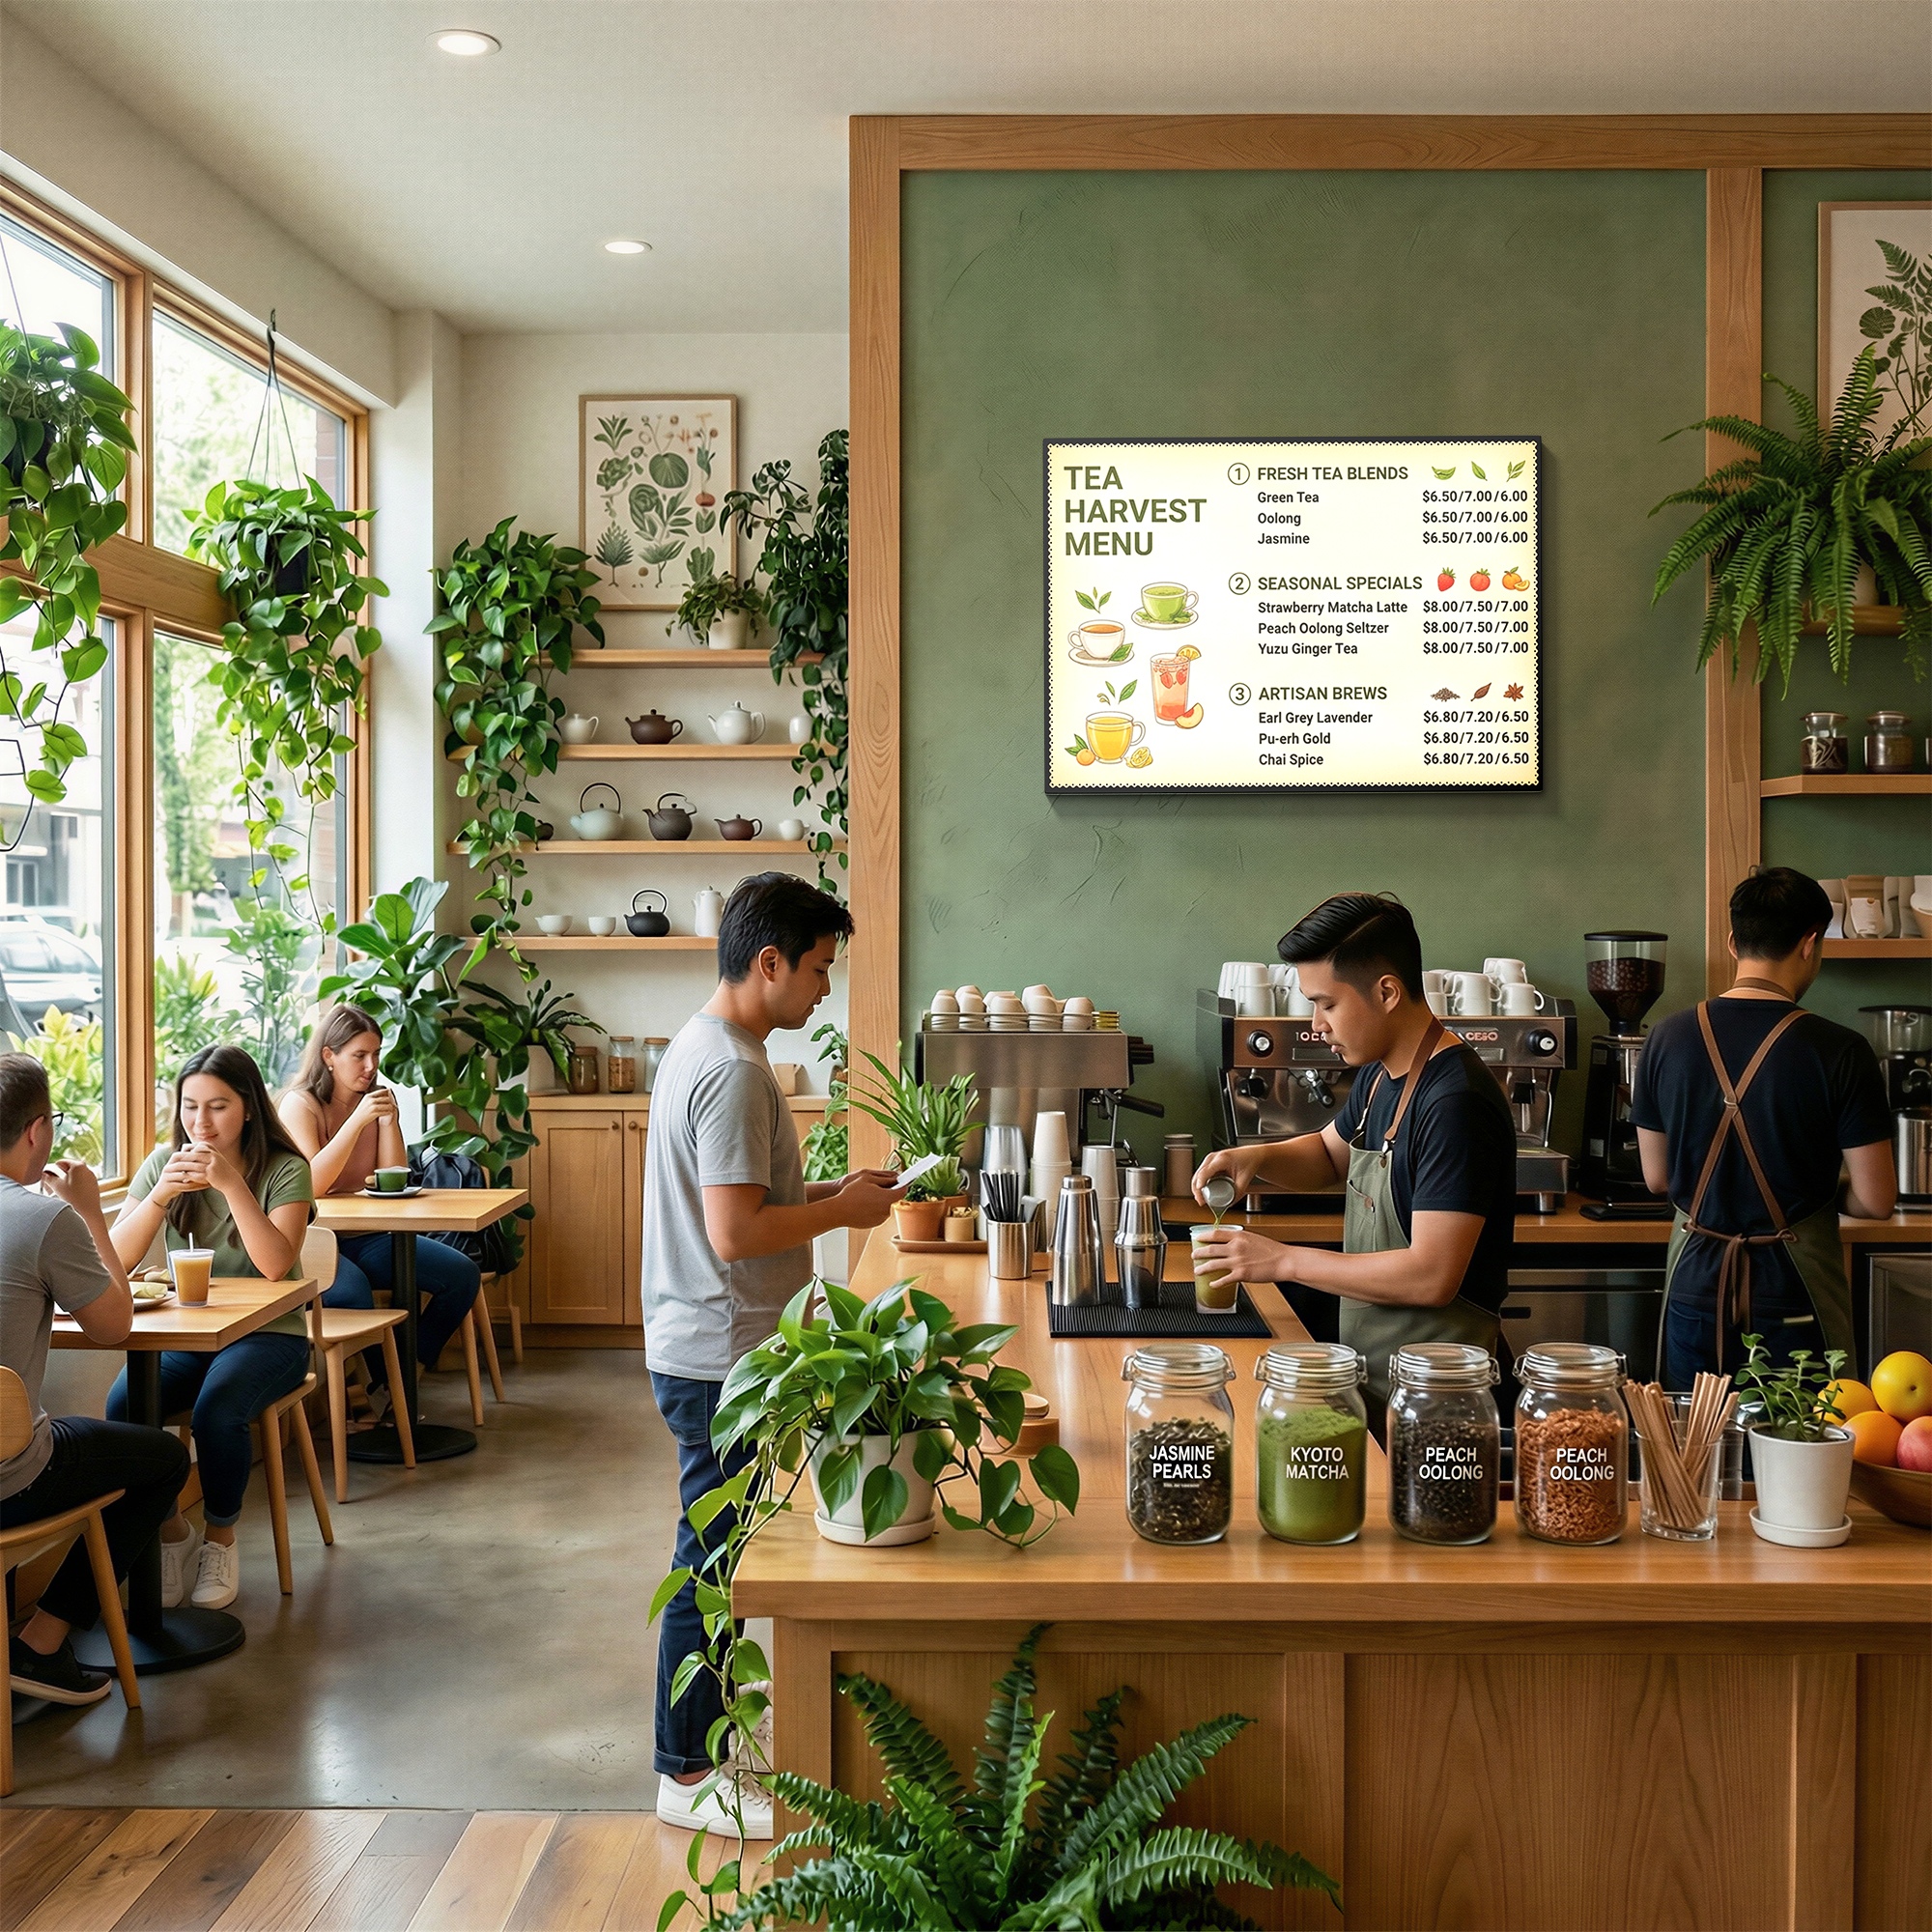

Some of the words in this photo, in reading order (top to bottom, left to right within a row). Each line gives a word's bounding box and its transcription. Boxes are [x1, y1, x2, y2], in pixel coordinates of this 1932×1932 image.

[1064, 467, 1122, 490] TEA
[1259, 468, 1307, 480] FRESH
[1312, 468, 1343, 479] TEA
[1348, 467, 1407, 479] BLENDS
[1258, 492, 1293, 502] Green
[1296, 492, 1319, 502] Tea
[1423, 490, 1527, 503] $6.50/7.00/6.00
[1065, 499, 1207, 523] HARVEST
[1258, 512, 1300, 526] Oolong
[1423, 511, 1527, 524] $6.50/7.00/6.00
[1065, 532, 1152, 555] MENU
[1258, 532, 1310, 544] Jasmine
[1423, 531, 1527, 544] $6.50/7.00/6.00
[1259, 577, 1342, 590] SEASONAL
[1347, 577, 1422, 589] SPECIALS
[1259, 601, 1324, 615] Strawberry
[1328, 601, 1373, 612] Matcha
[1378, 602, 1407, 612] Latte
[1423, 601, 1528, 613] $8.00/7.50/7.00
[1259, 622, 1295, 634] Peach
[1299, 622, 1342, 637] Oolong
[1347, 622, 1389, 633] Seltzer
[1423, 621, 1528, 634] $8.00/7.50/7.00
[1259, 643, 1288, 654] Yuzu
[1293, 643, 1332, 657] Ginger
[1335, 643, 1357, 654] Tea
[1423, 641, 1528, 654] $8.00/7.50/7.00
[1259, 687, 1327, 700] ARTISAN
[1333, 687, 1387, 699] BREWS
[1260, 712, 1281, 723] Earl
[1286, 712, 1313, 726] Grey
[1318, 711, 1373, 723] Lavender
[1424, 710, 1528, 724] $6.80/7.20/6.50
[1260, 732, 1299, 744] Pu-erh
[1303, 732, 1330, 744] Gold
[1424, 731, 1528, 745] $6.80/7.20/6.50
[1260, 753, 1286, 765] Chai
[1290, 753, 1323, 768] Spice
[1424, 753, 1529, 765] $6.80/7.20/6.50
[1150, 1446, 1214, 1461] JASMINE
[1292, 1447, 1343, 1462] KYOTO
[1427, 1447, 1476, 1462] PEACH
[1557, 1448, 1605, 1463] PEACH
[1153, 1463, 1210, 1478] PEARLS
[1287, 1464, 1347, 1479] MATCHA
[1420, 1464, 1482, 1479] OOLONG
[1550, 1466, 1613, 1480] OOLONG
